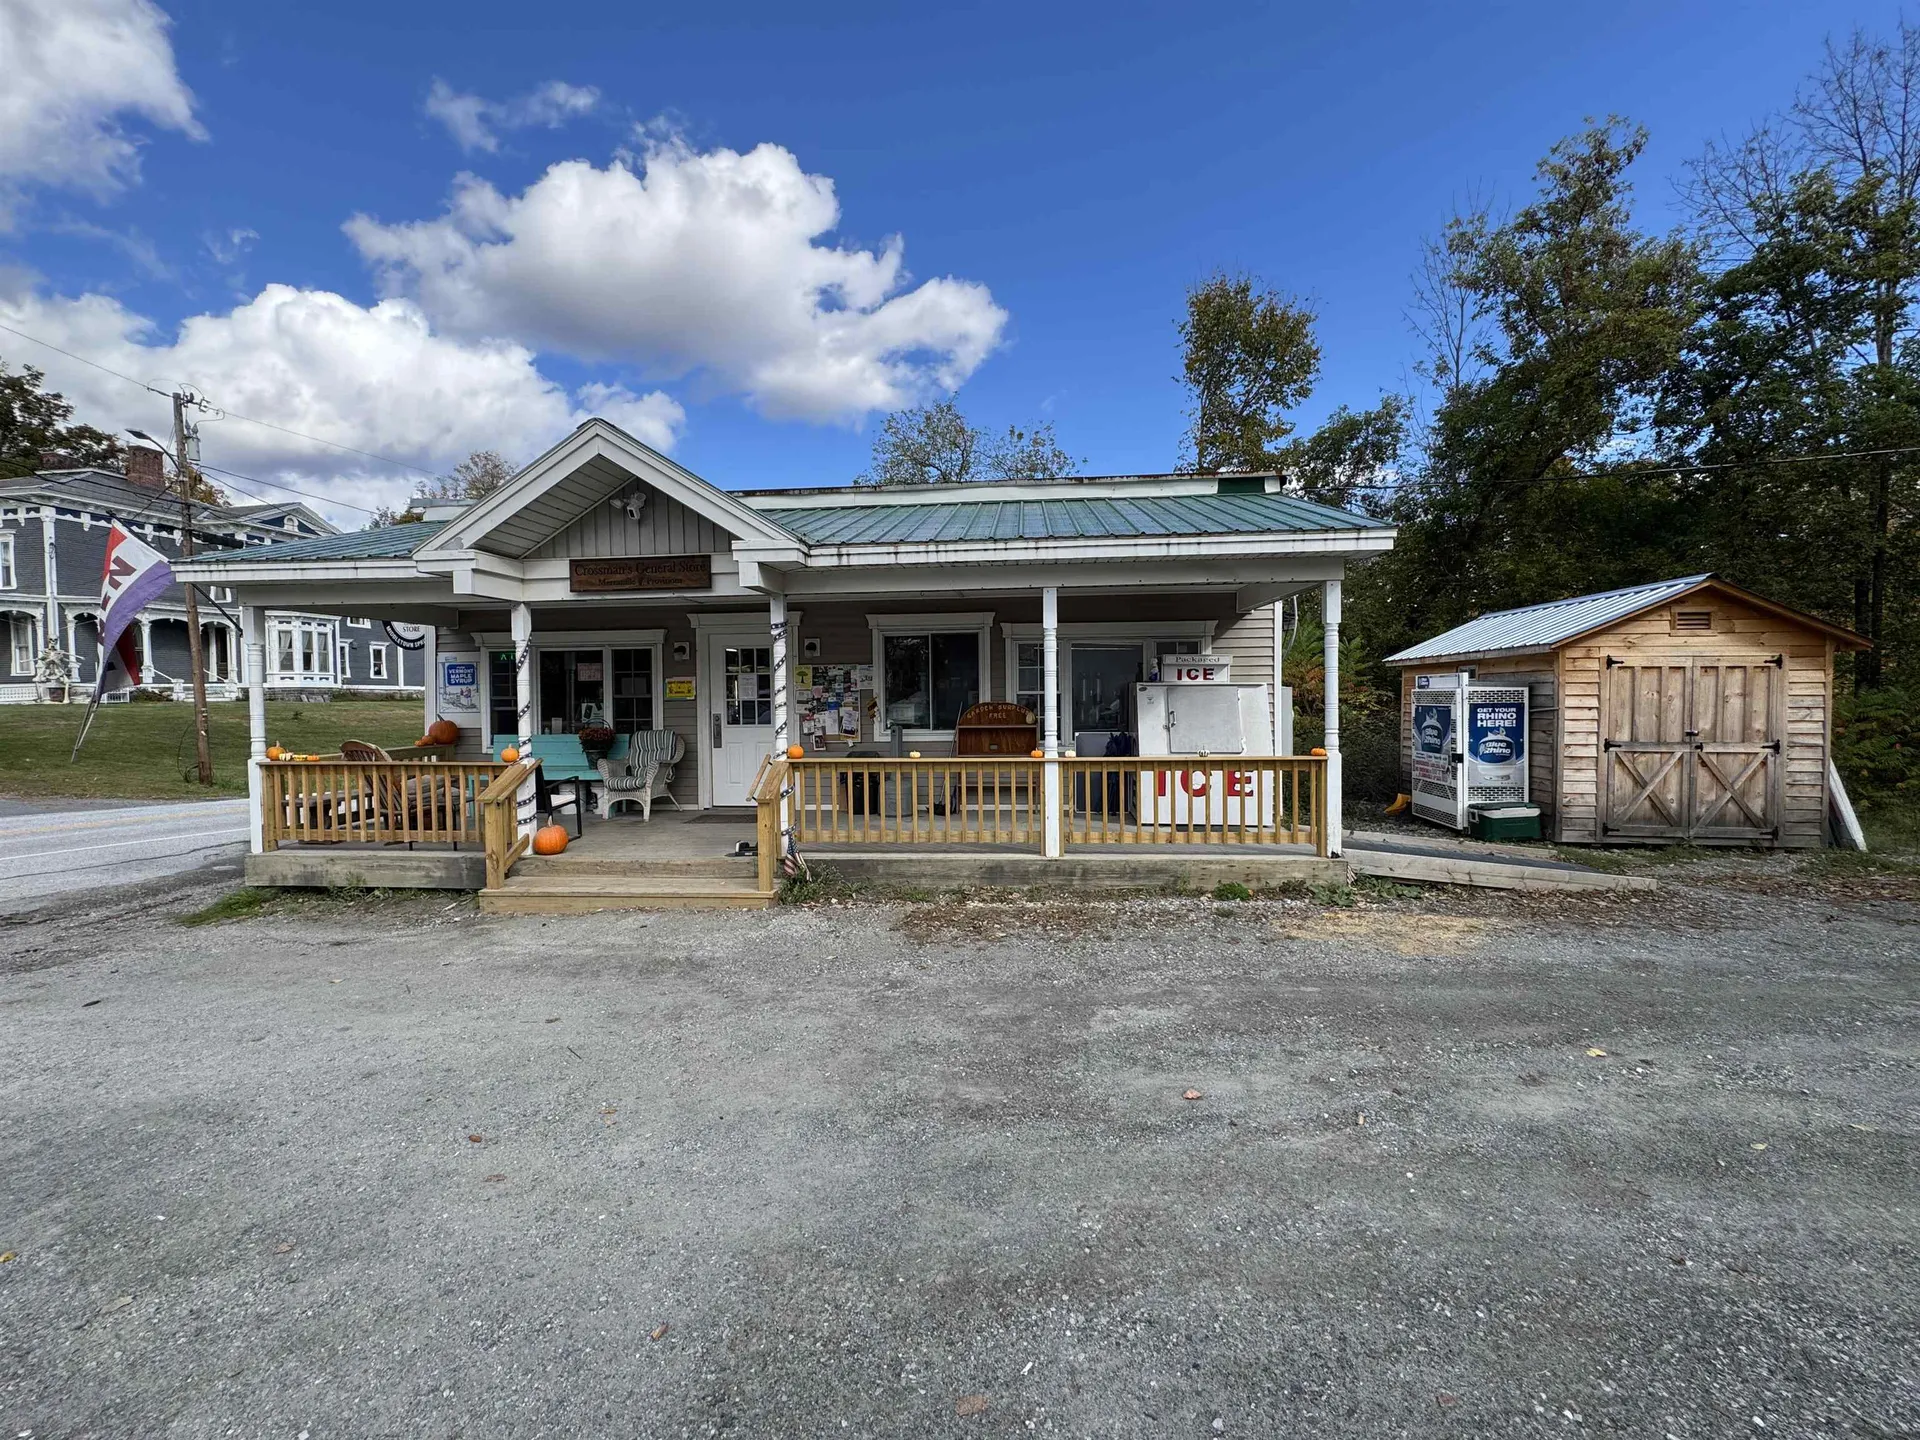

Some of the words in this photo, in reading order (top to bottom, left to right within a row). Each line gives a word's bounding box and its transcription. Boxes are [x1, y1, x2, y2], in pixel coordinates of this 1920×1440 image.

[575, 563, 633, 576] Crossman's
[636, 561, 676, 575] General
[679, 560, 707, 573] Store
[385, 625, 414, 648] MIDDLETOWN
[1176, 667, 1215, 681] ICE
[966, 705, 994, 719] GARDEN
[1477, 712, 1517, 720] RHINO
[1477, 719, 1517, 728] HERE!
[1157, 770, 1254, 797] ICE
